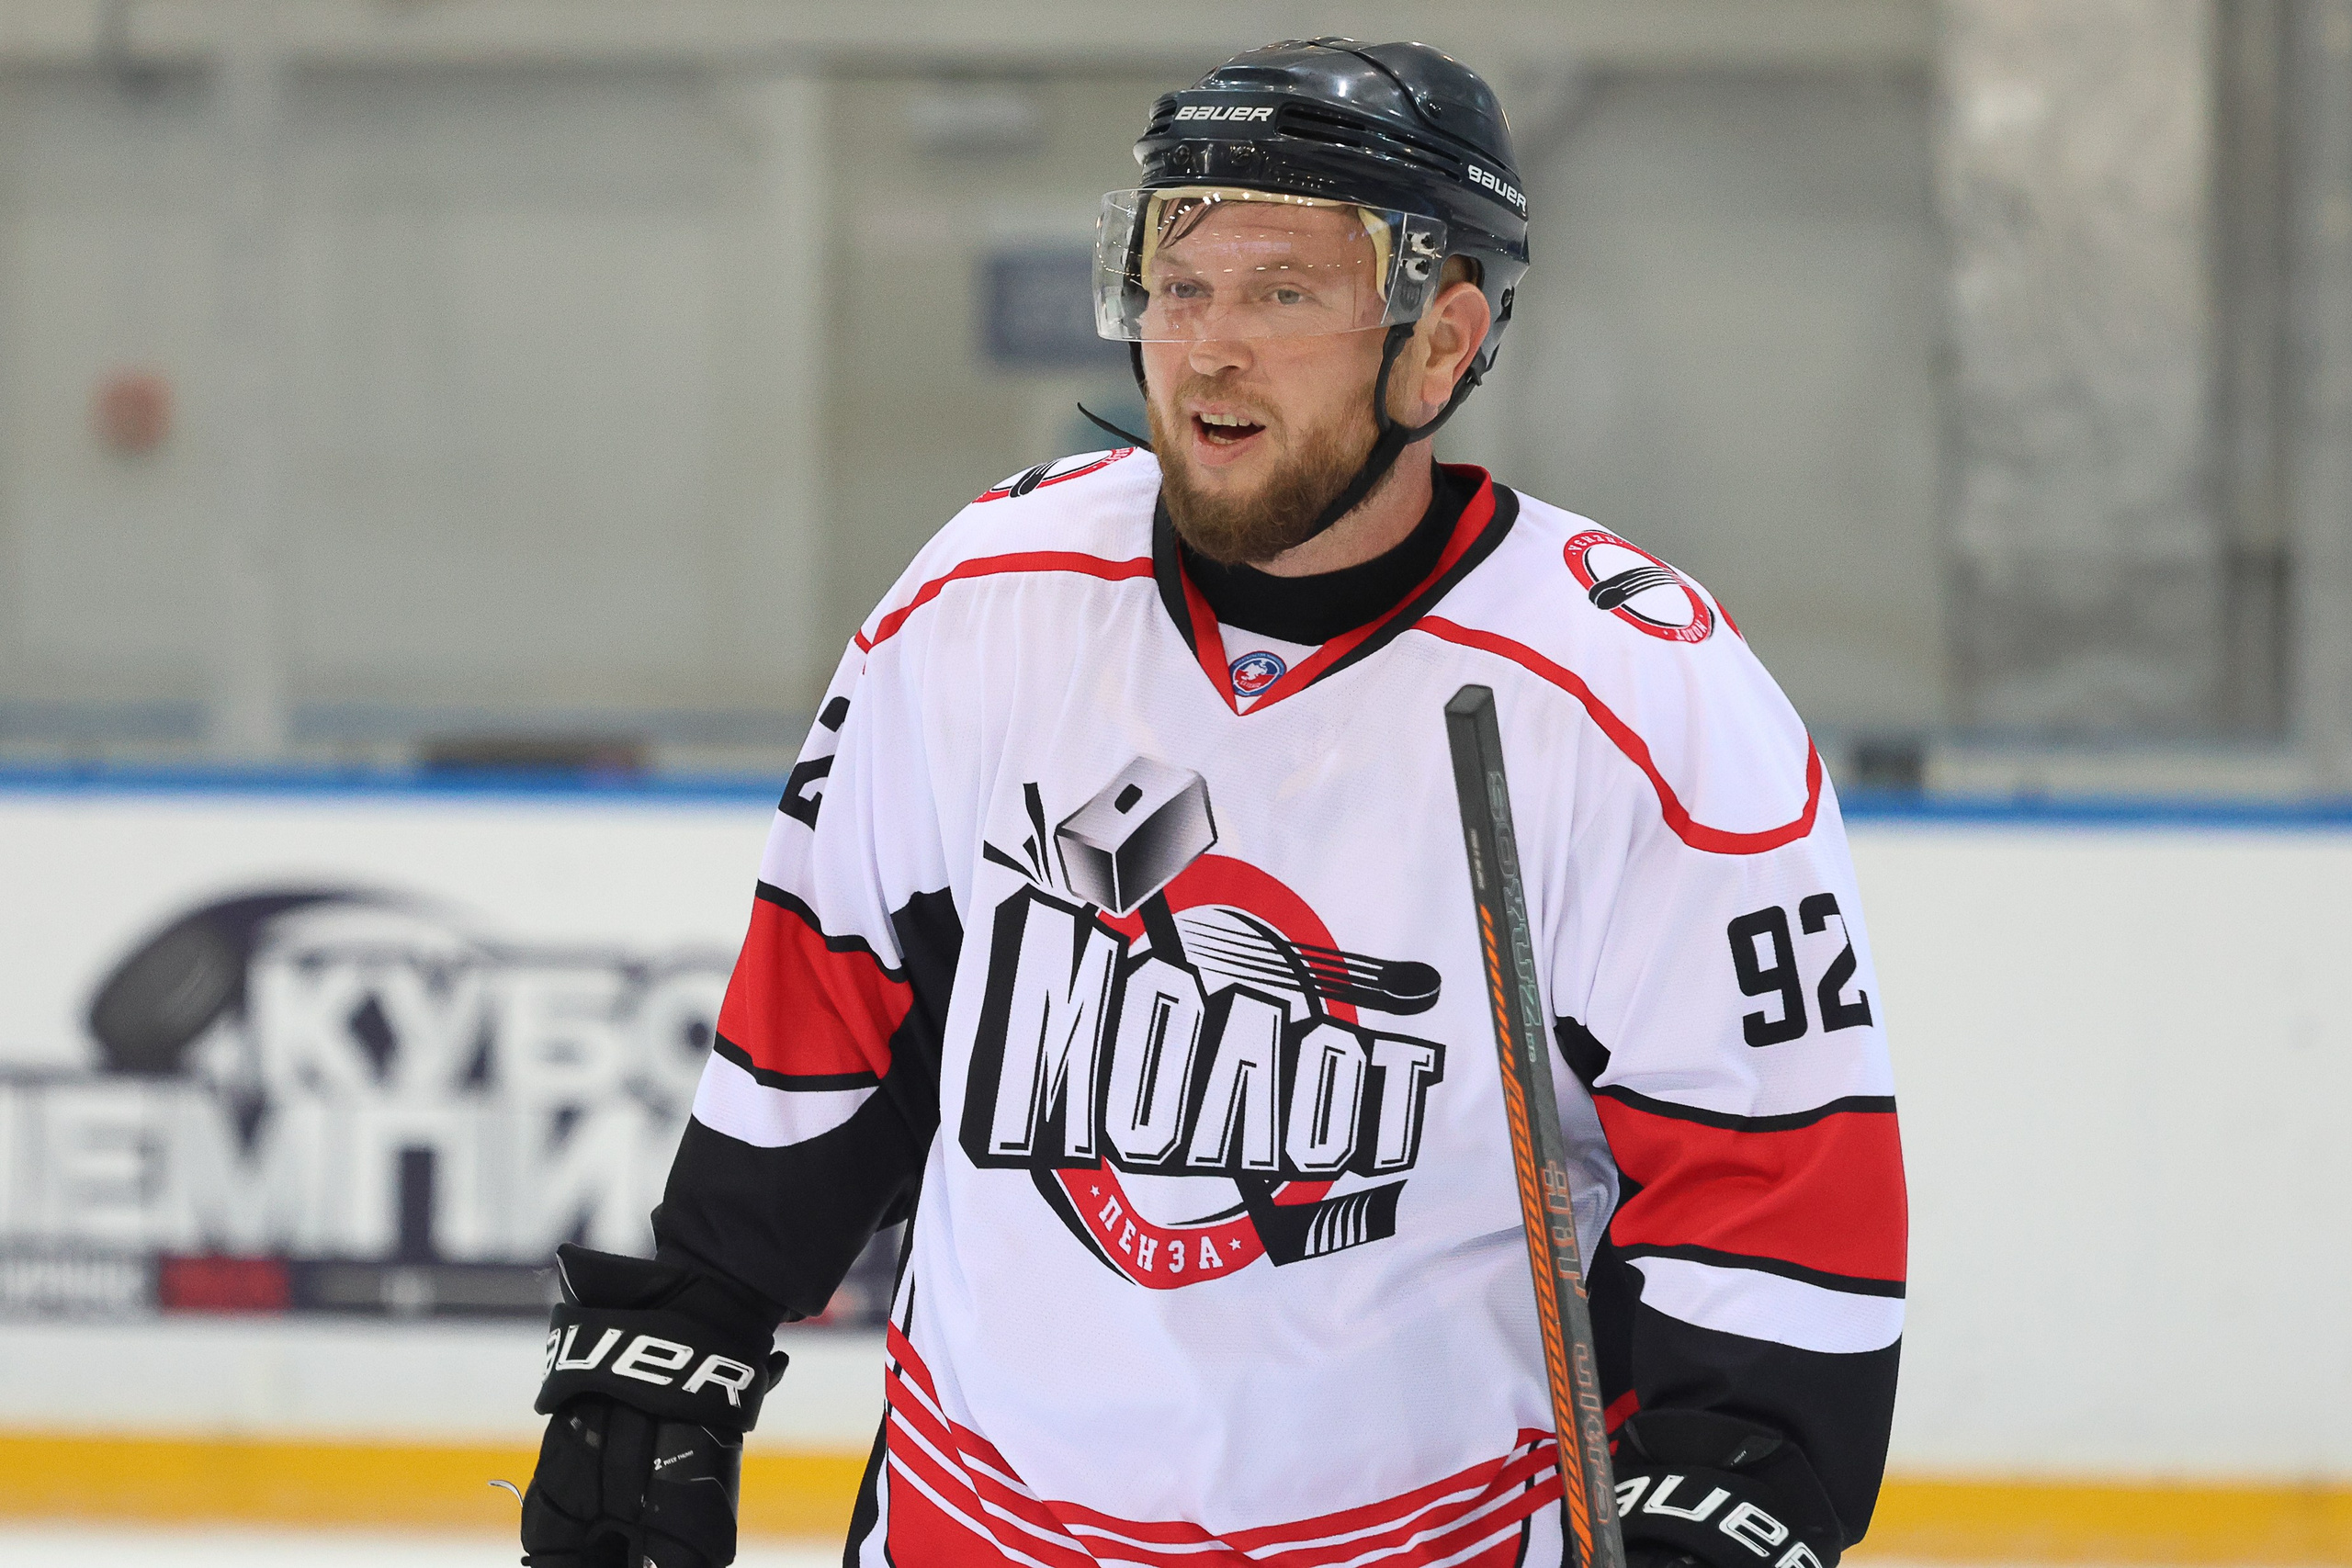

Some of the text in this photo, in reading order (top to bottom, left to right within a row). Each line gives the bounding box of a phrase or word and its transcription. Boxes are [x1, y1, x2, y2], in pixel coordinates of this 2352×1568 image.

[1174, 105, 1274, 123] BAUER
[1467, 164, 1527, 208] BAUER
[1726, 892, 1874, 1048] 92
[976, 887, 1442, 1175] МОЛОТ
[1098, 1194, 1223, 1273] ПЕНЗА
